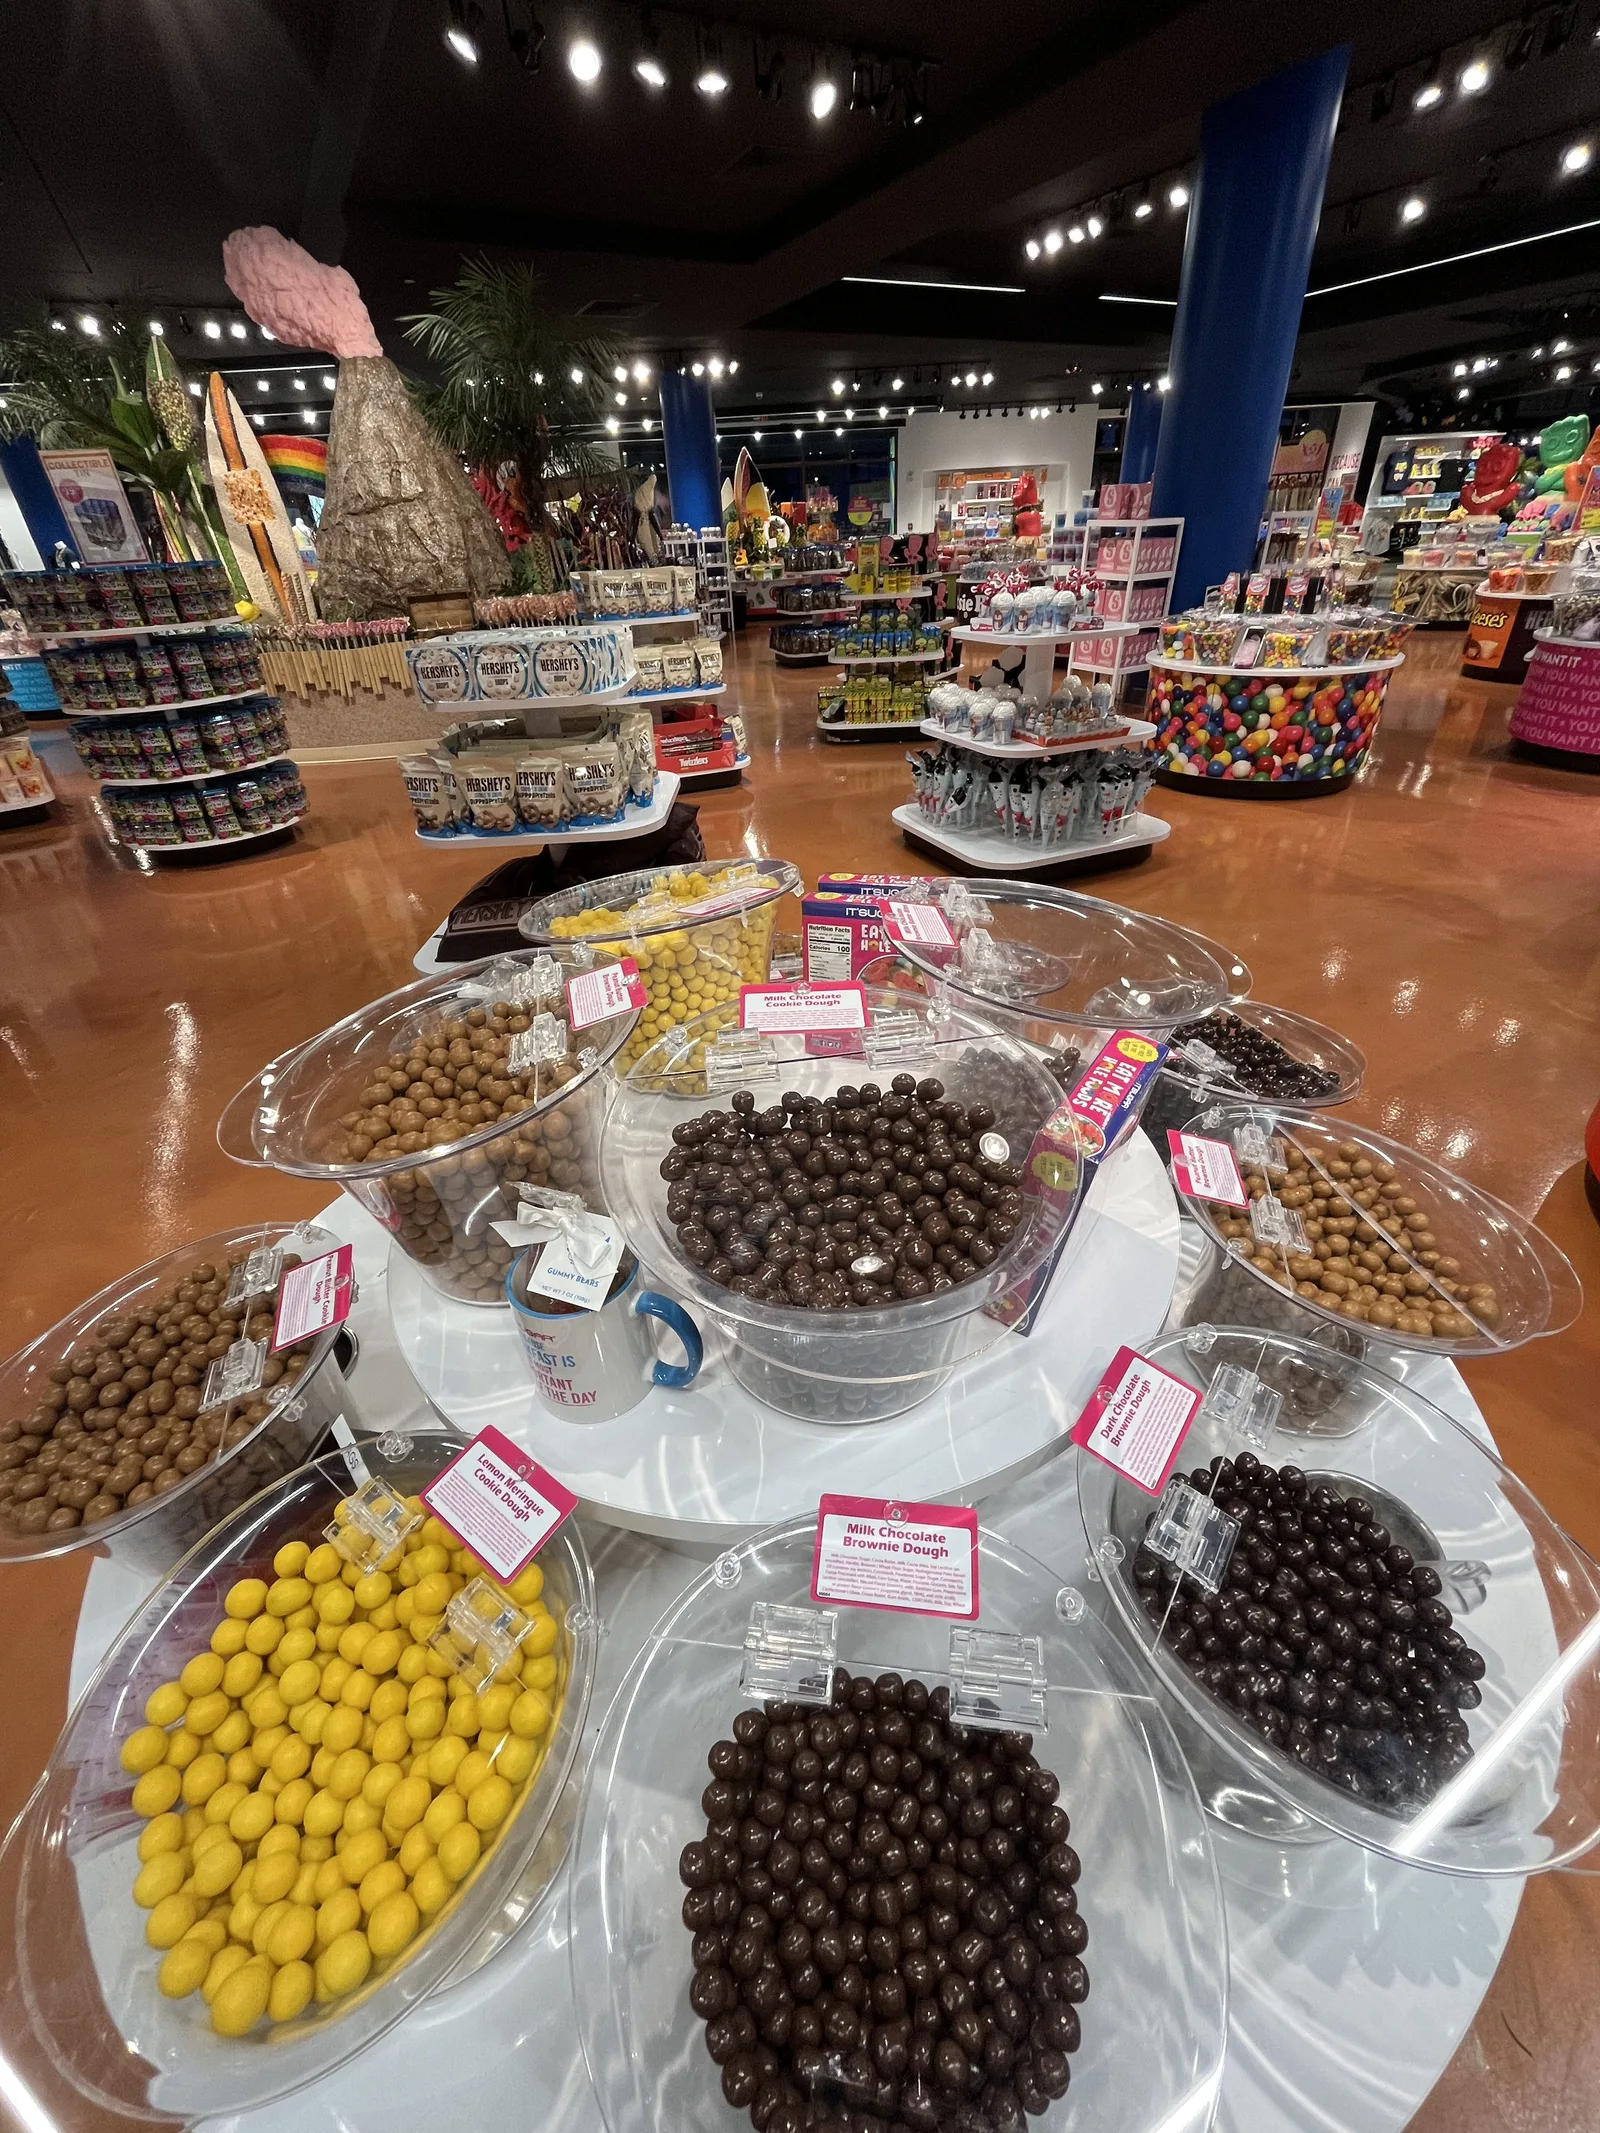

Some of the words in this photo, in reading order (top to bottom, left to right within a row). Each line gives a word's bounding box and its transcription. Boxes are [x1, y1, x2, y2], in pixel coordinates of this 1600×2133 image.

[47, 459, 110, 470] COLLECTIBLE
[1331, 453, 1361, 471] BECAUSE
[480, 661, 520, 676] HERSHEY'S
[540, 658, 579, 672] HERSHEY'S
[1542, 653, 1568, 667] WANT
[1567, 656, 1581, 669] IT
[420, 664, 460, 679] HERSHEY'S
[1546, 669, 1567, 681] YOU
[1556, 686, 1570, 698] IT
[1535, 699, 1557, 712] YOU
[1558, 703, 1600, 718] WANT
[1545, 715, 1558, 727] IT
[1525, 726, 1546, 739] YOU
[1547, 731, 1590, 748] WANT
[679, 756, 709, 767] Twizzlers
[466, 776, 511, 793] HERSHEY'S
[606, 991, 616, 1008] Dough
[1092, 1056, 1118, 1078] HOLE
[1112, 1062, 1138, 1084] EAT
[1072, 1076, 1104, 1108] FOODS
[1089, 1080, 1125, 1117] MORE
[547, 1267, 575, 1281] GUMMY
[576, 1275, 600, 1288] BEARS
[312, 1281, 323, 1304] Dough
[323, 1278, 332, 1299] Butter
[321, 1300, 330, 1324] Cookie
[562, 1356, 576, 1368] IS
[547, 1386, 568, 1403] THE
[571, 1390, 597, 1404] DAY
[1100, 1416, 1118, 1439] Dark
[1113, 1374, 1141, 1416] Chocolate
[1111, 1411, 1136, 1447] Brownie
[1131, 1379, 1152, 1411] Dough
[477, 1453, 506, 1481] Lemon
[503, 1478, 545, 1517] Meringue
[474, 1468, 501, 1496] Cookie
[500, 1492, 531, 1522] Dough
[847, 1523, 875, 1537] Milk
[878, 1527, 947, 1543] Chocolate
[842, 1536, 900, 1553] Brownie
[903, 1543, 949, 1560] Dough
